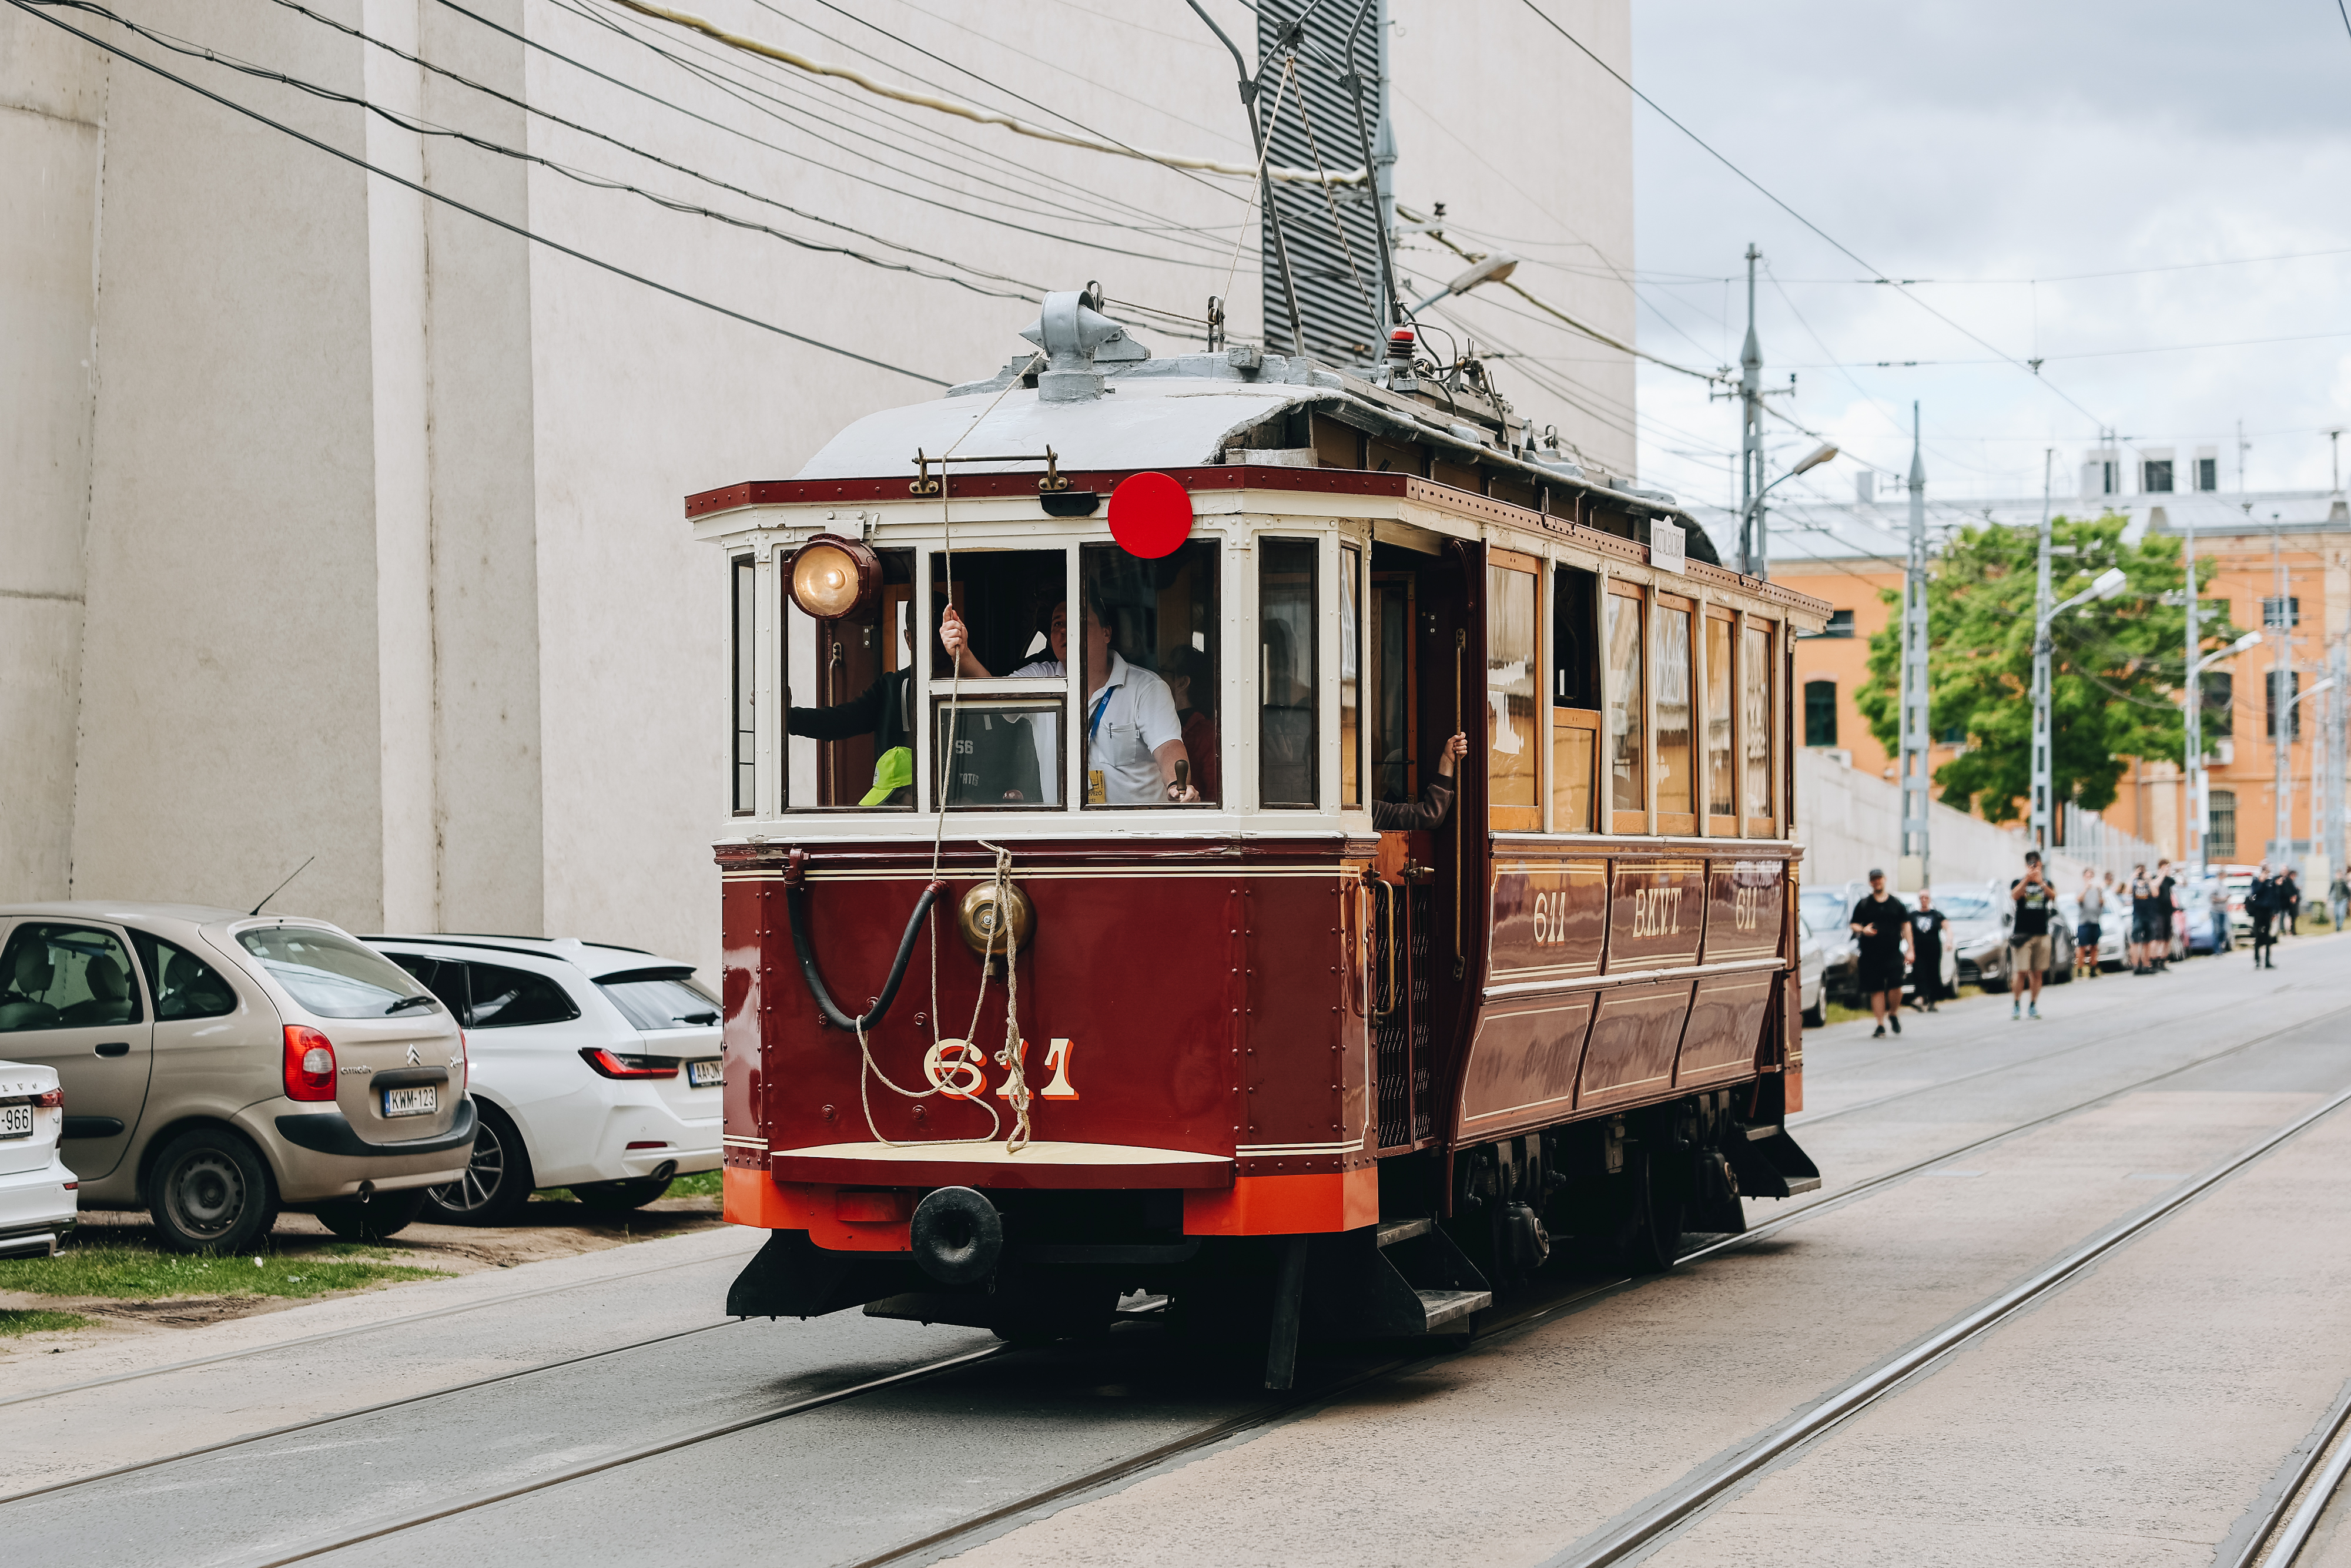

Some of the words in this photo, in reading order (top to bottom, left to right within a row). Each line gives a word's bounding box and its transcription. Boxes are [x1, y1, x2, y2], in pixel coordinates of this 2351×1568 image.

[955, 740, 973, 754] 56
[1533, 892, 1566, 945] 611
[1736, 887, 1757, 930] 611
[341, 1064, 372, 1075] CITROËN
[709, 1061, 723, 1079] JN-
[923, 1038, 1079, 1100] 611
[2, 1083, 37, 1092] LVO
[392, 1088, 434, 1110] KWM-123
